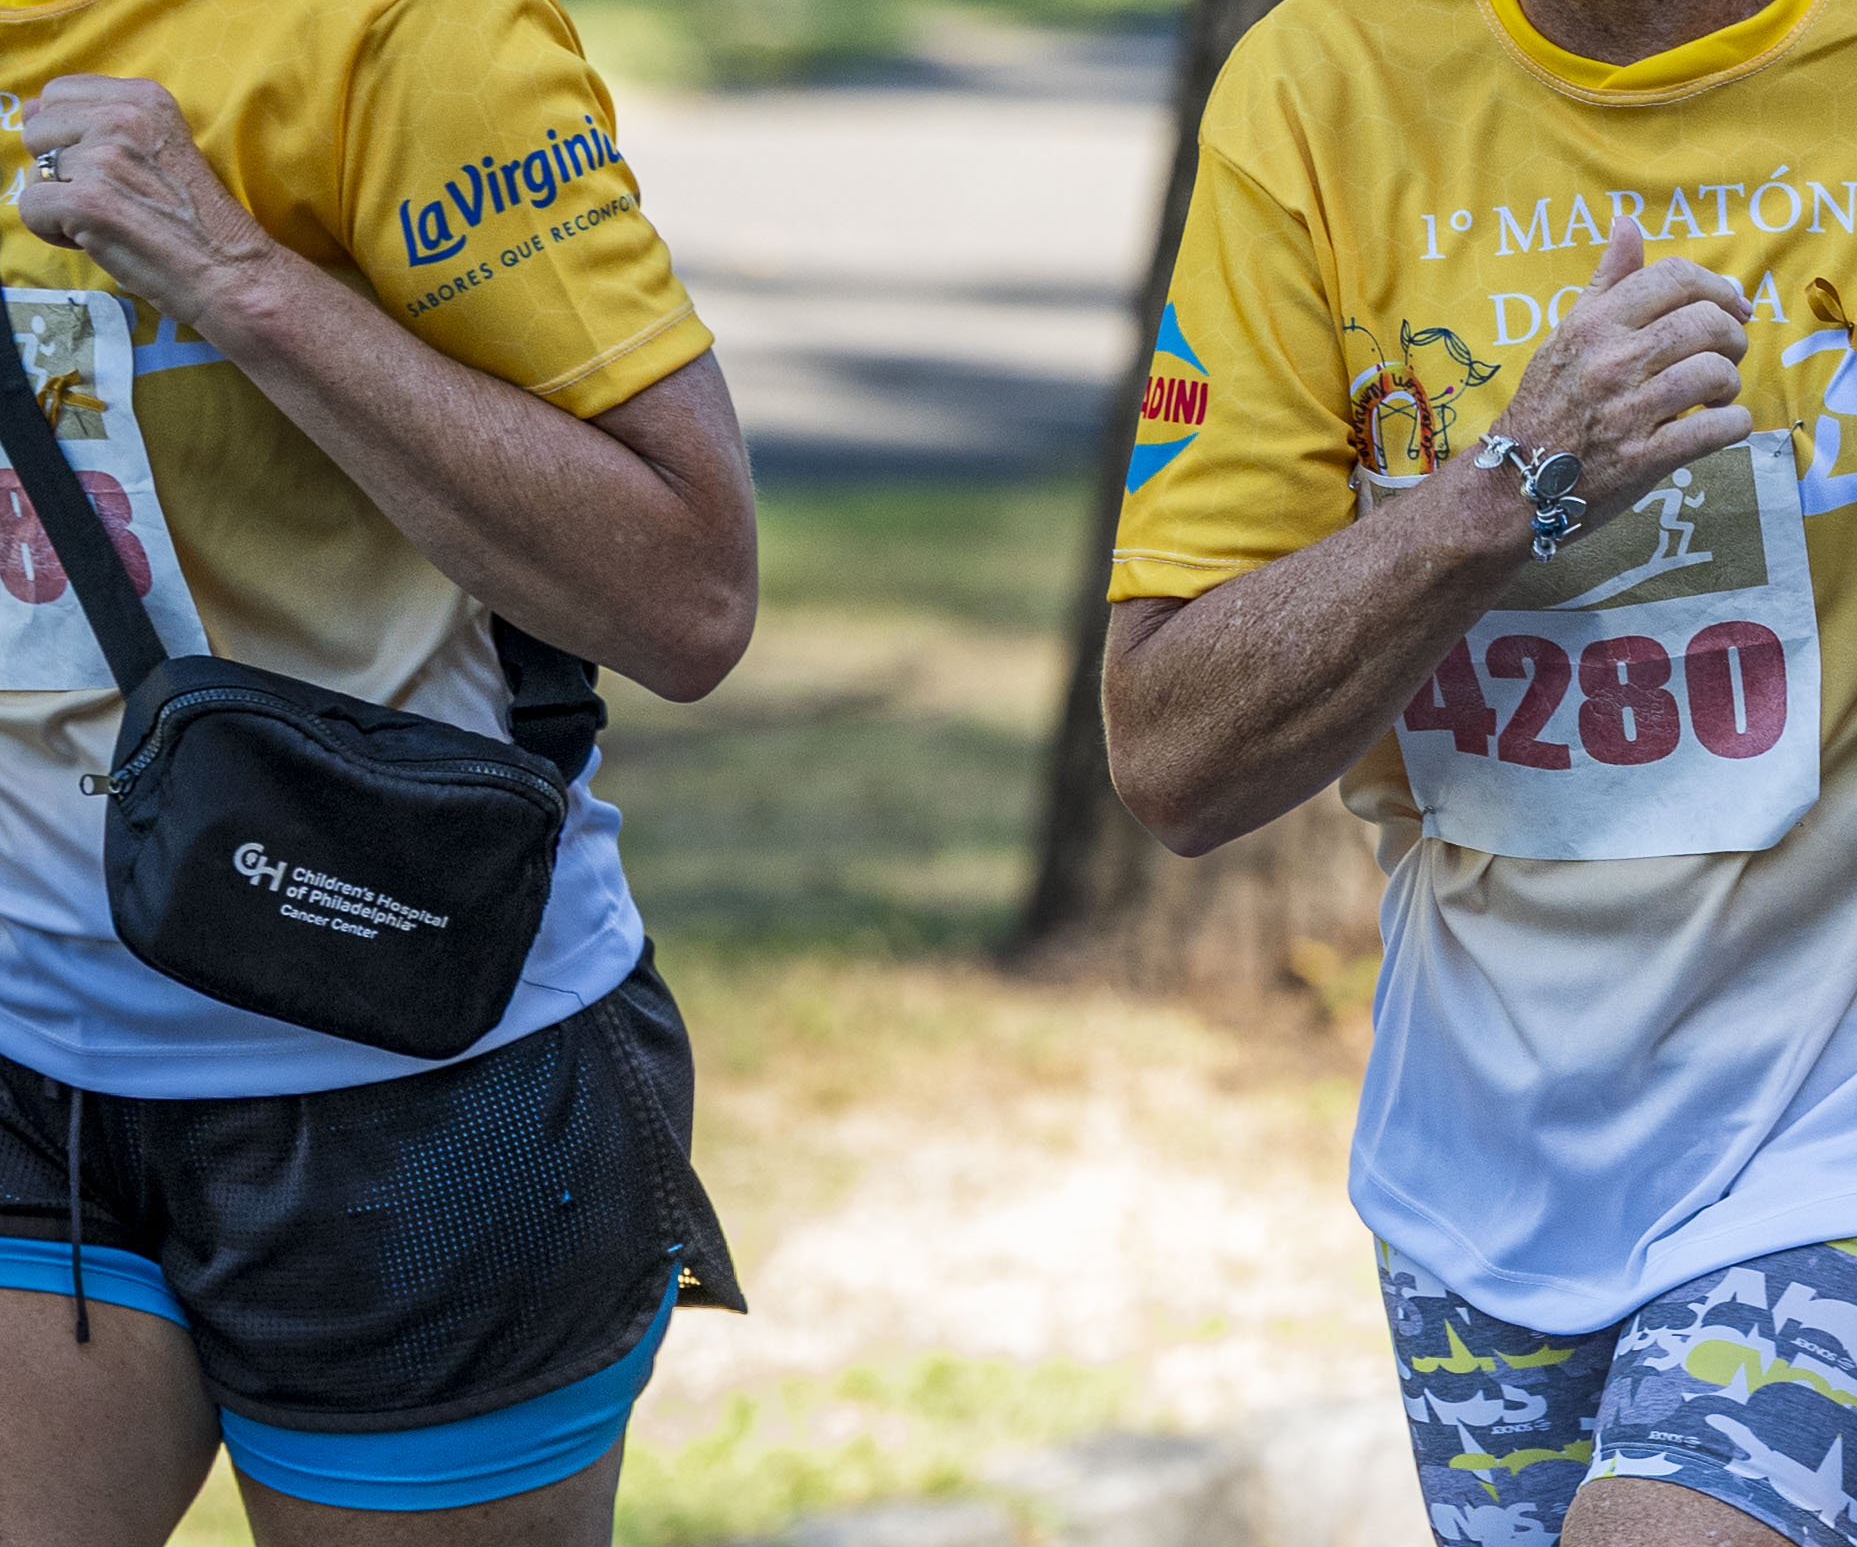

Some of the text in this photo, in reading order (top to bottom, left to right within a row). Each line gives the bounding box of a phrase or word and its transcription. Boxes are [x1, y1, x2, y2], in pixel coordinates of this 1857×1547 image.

[406, 262, 494, 318] SABORES
[501, 234, 545, 267] QUE
[1403, 619, 1787, 770] 4280
[280, 904, 378, 939] Cancer Center
[286, 886, 417, 932] of Philadelphia
[292, 867, 449, 928] Children's Hospital
